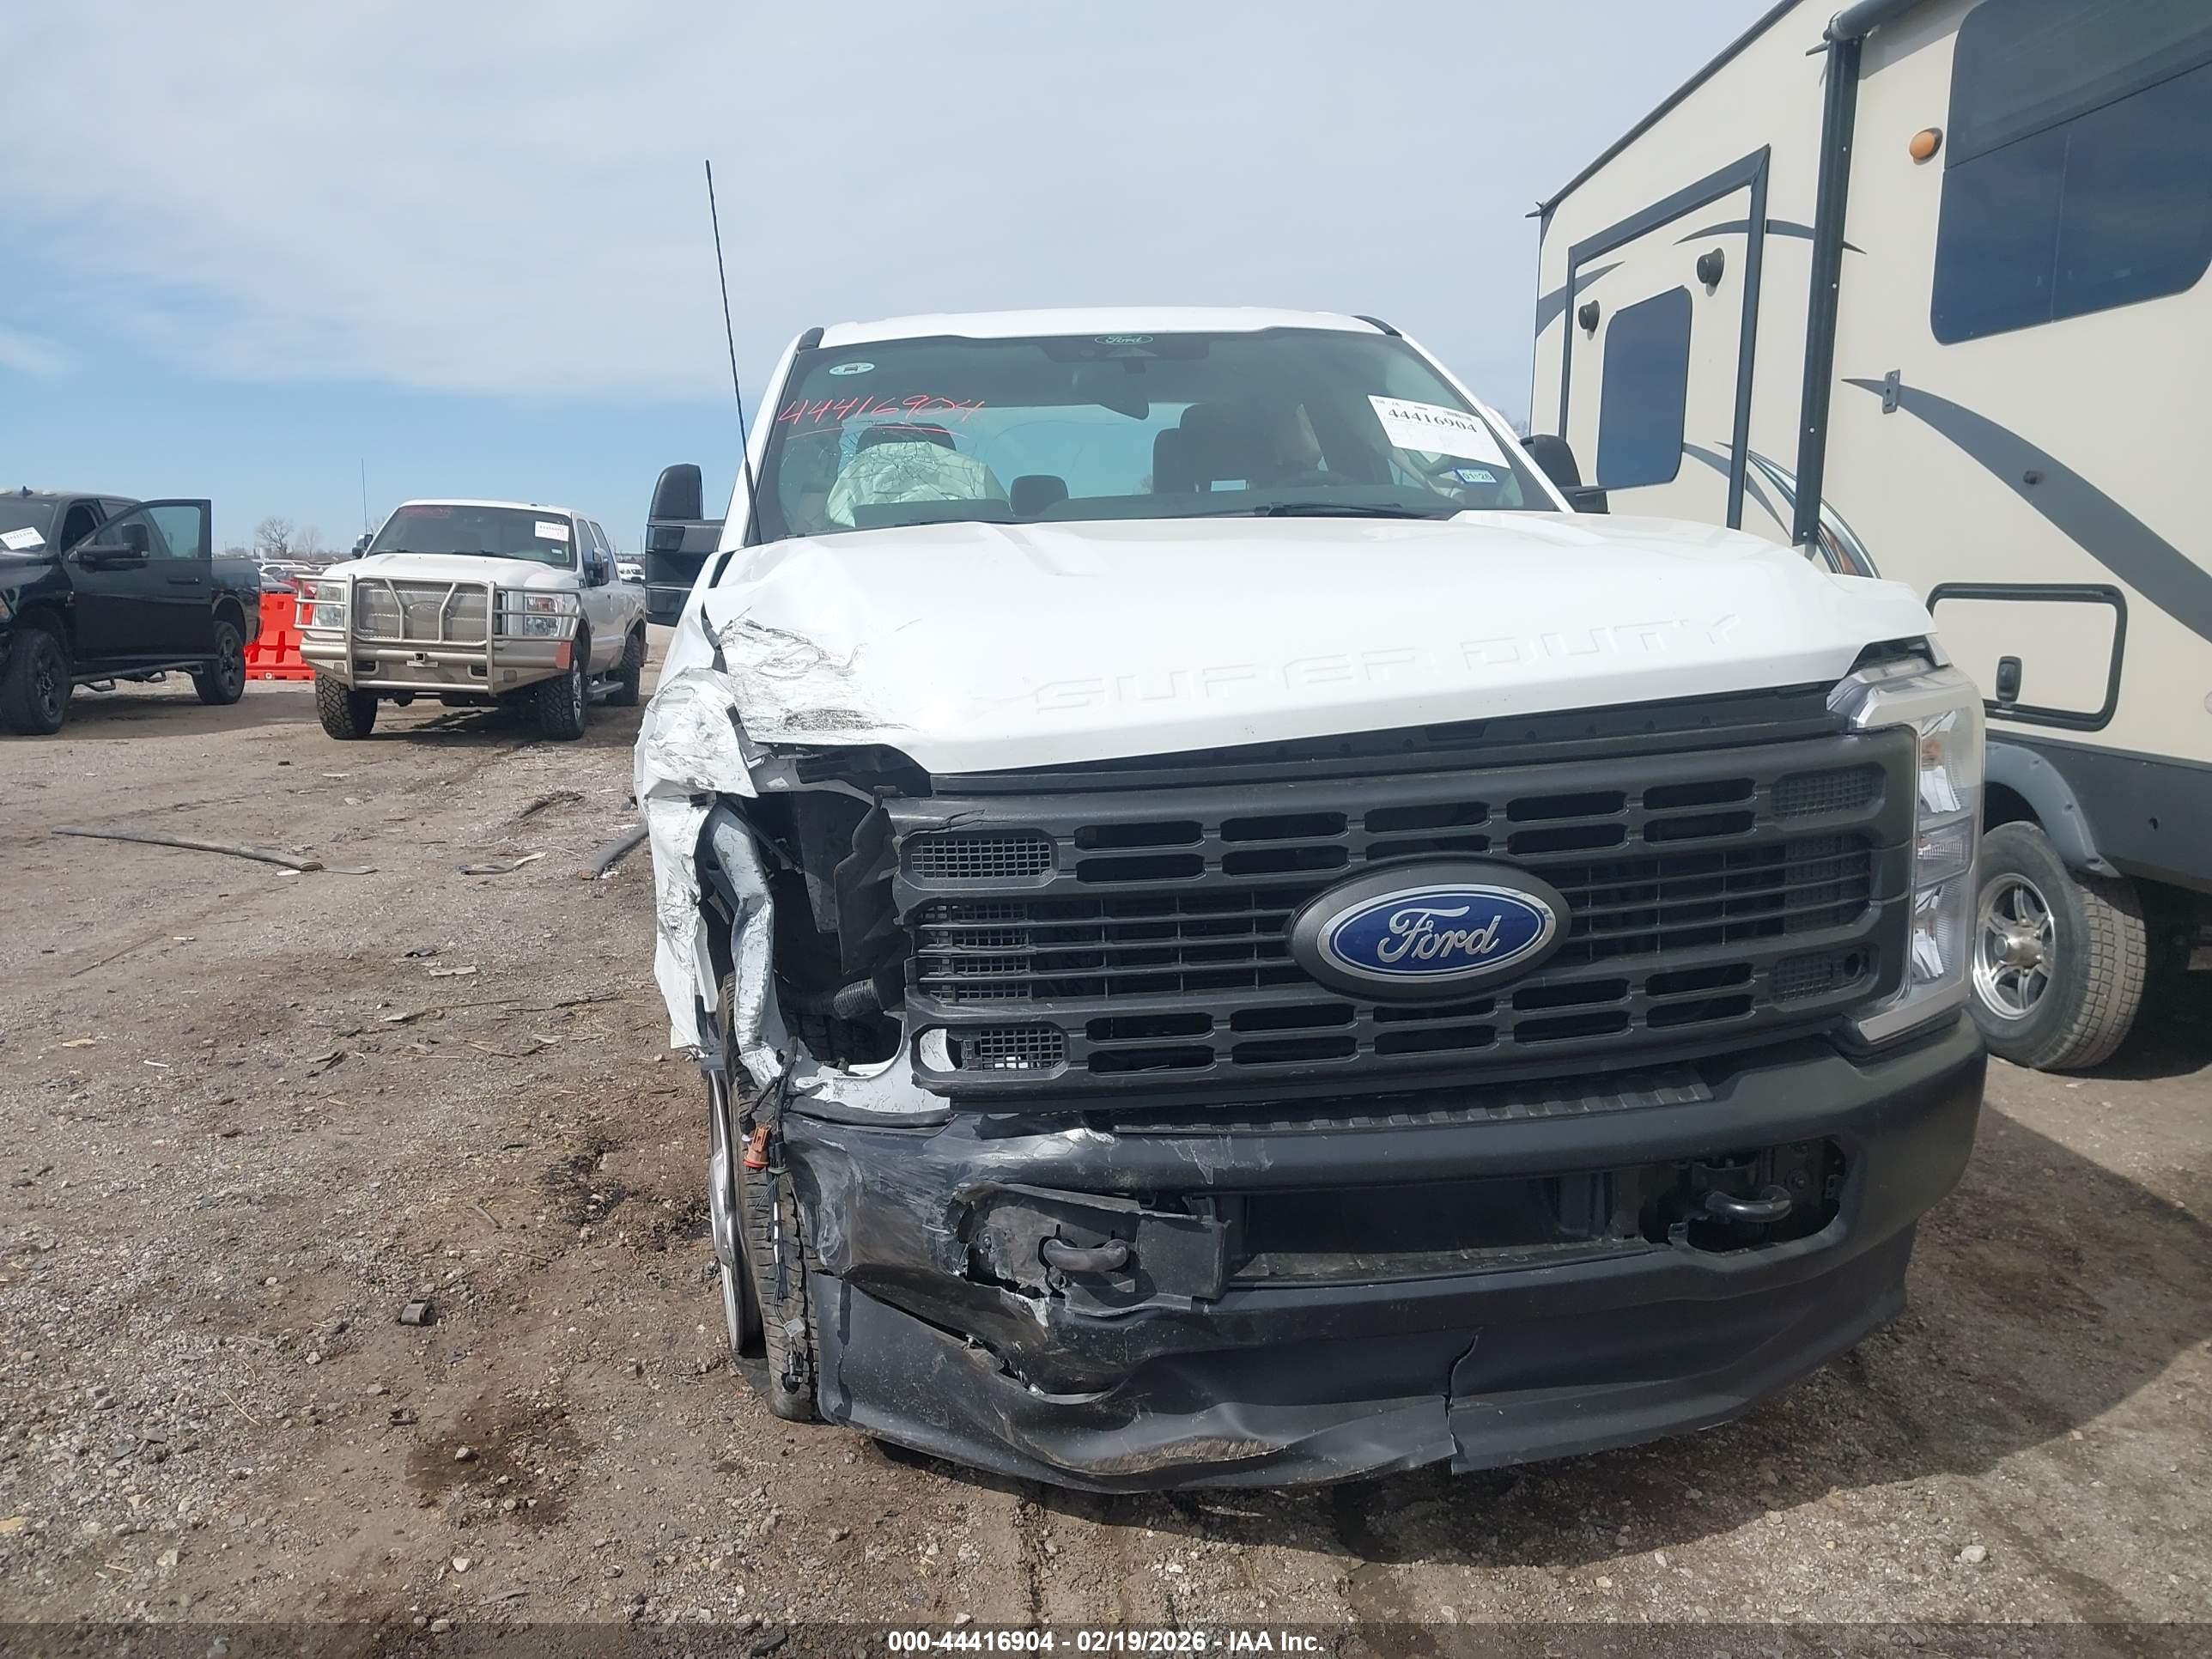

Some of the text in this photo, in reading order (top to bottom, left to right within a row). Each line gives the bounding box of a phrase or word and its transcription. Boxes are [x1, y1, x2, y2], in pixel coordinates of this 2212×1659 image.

[778, 394, 986, 425] 44416904
[1389, 409, 1478, 434] 44416904
[1034, 613, 1743, 714] SUPER DUTY
[1376, 905, 1500, 963] Ford
